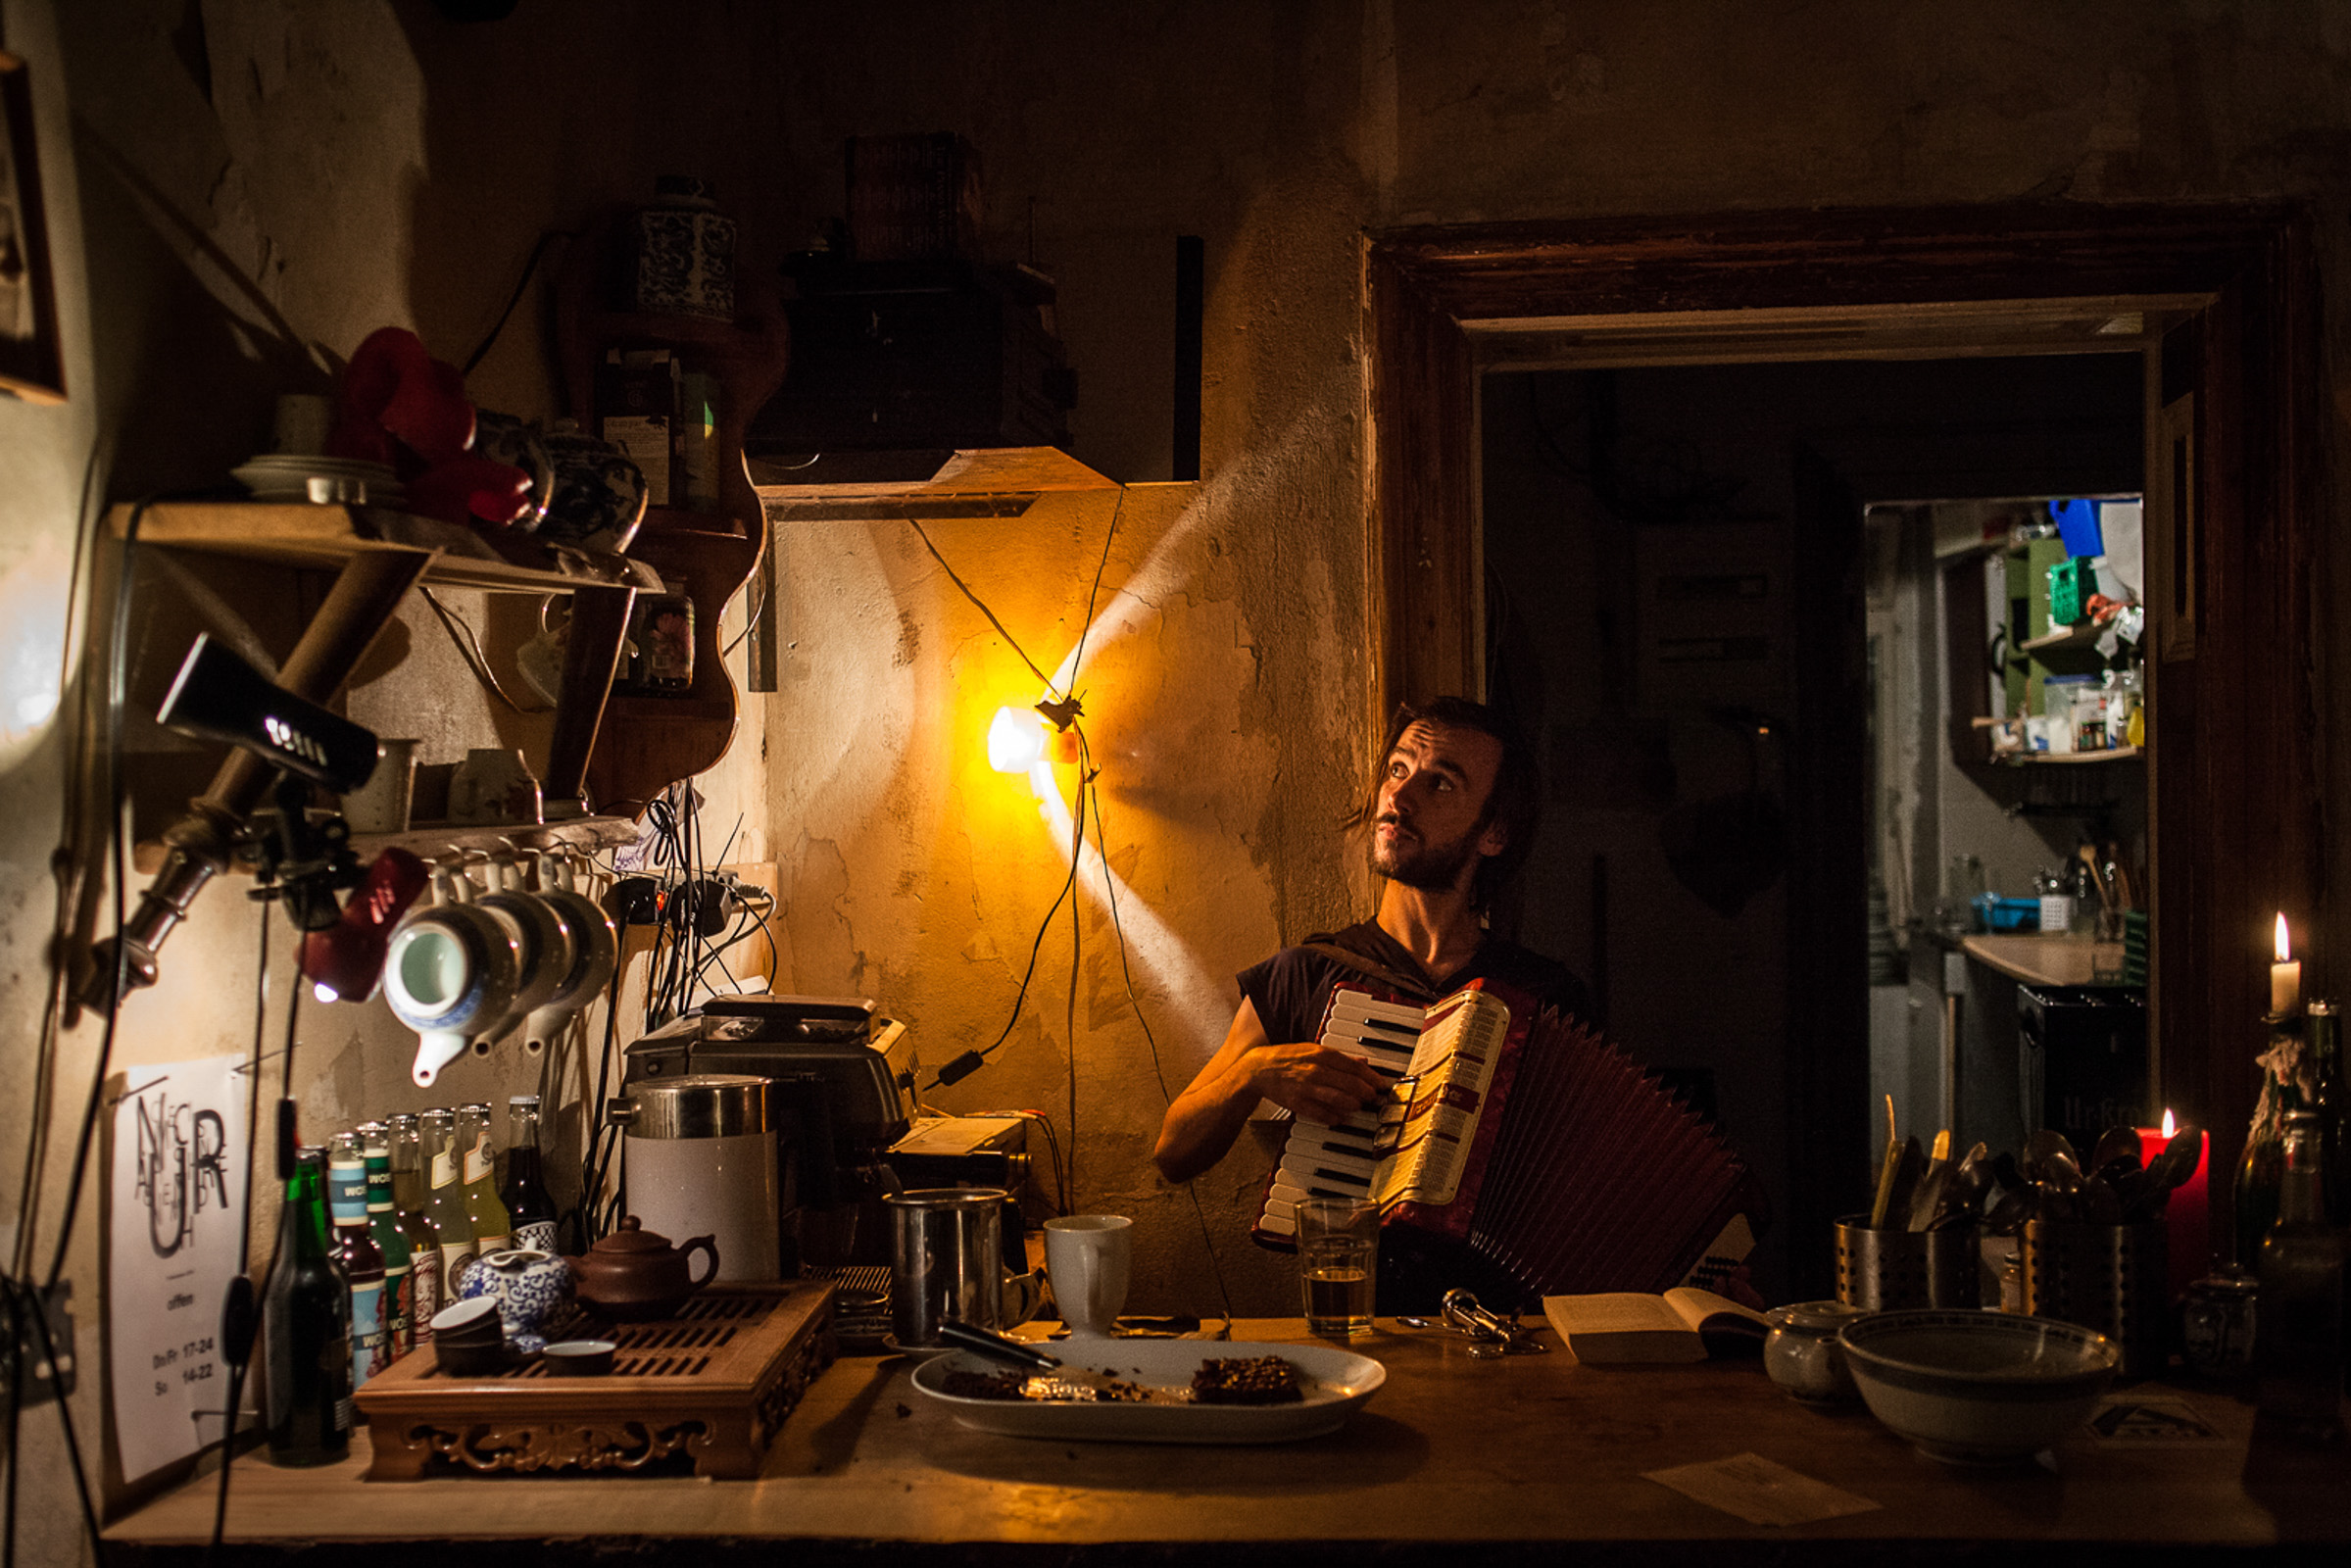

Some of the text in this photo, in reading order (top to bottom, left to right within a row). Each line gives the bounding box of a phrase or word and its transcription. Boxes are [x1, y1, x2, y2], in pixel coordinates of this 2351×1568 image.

[167, 1293, 194, 1311] offen
[182, 1337, 214, 1358] 17-24
[155, 1363, 213, 1396] So 14-22
